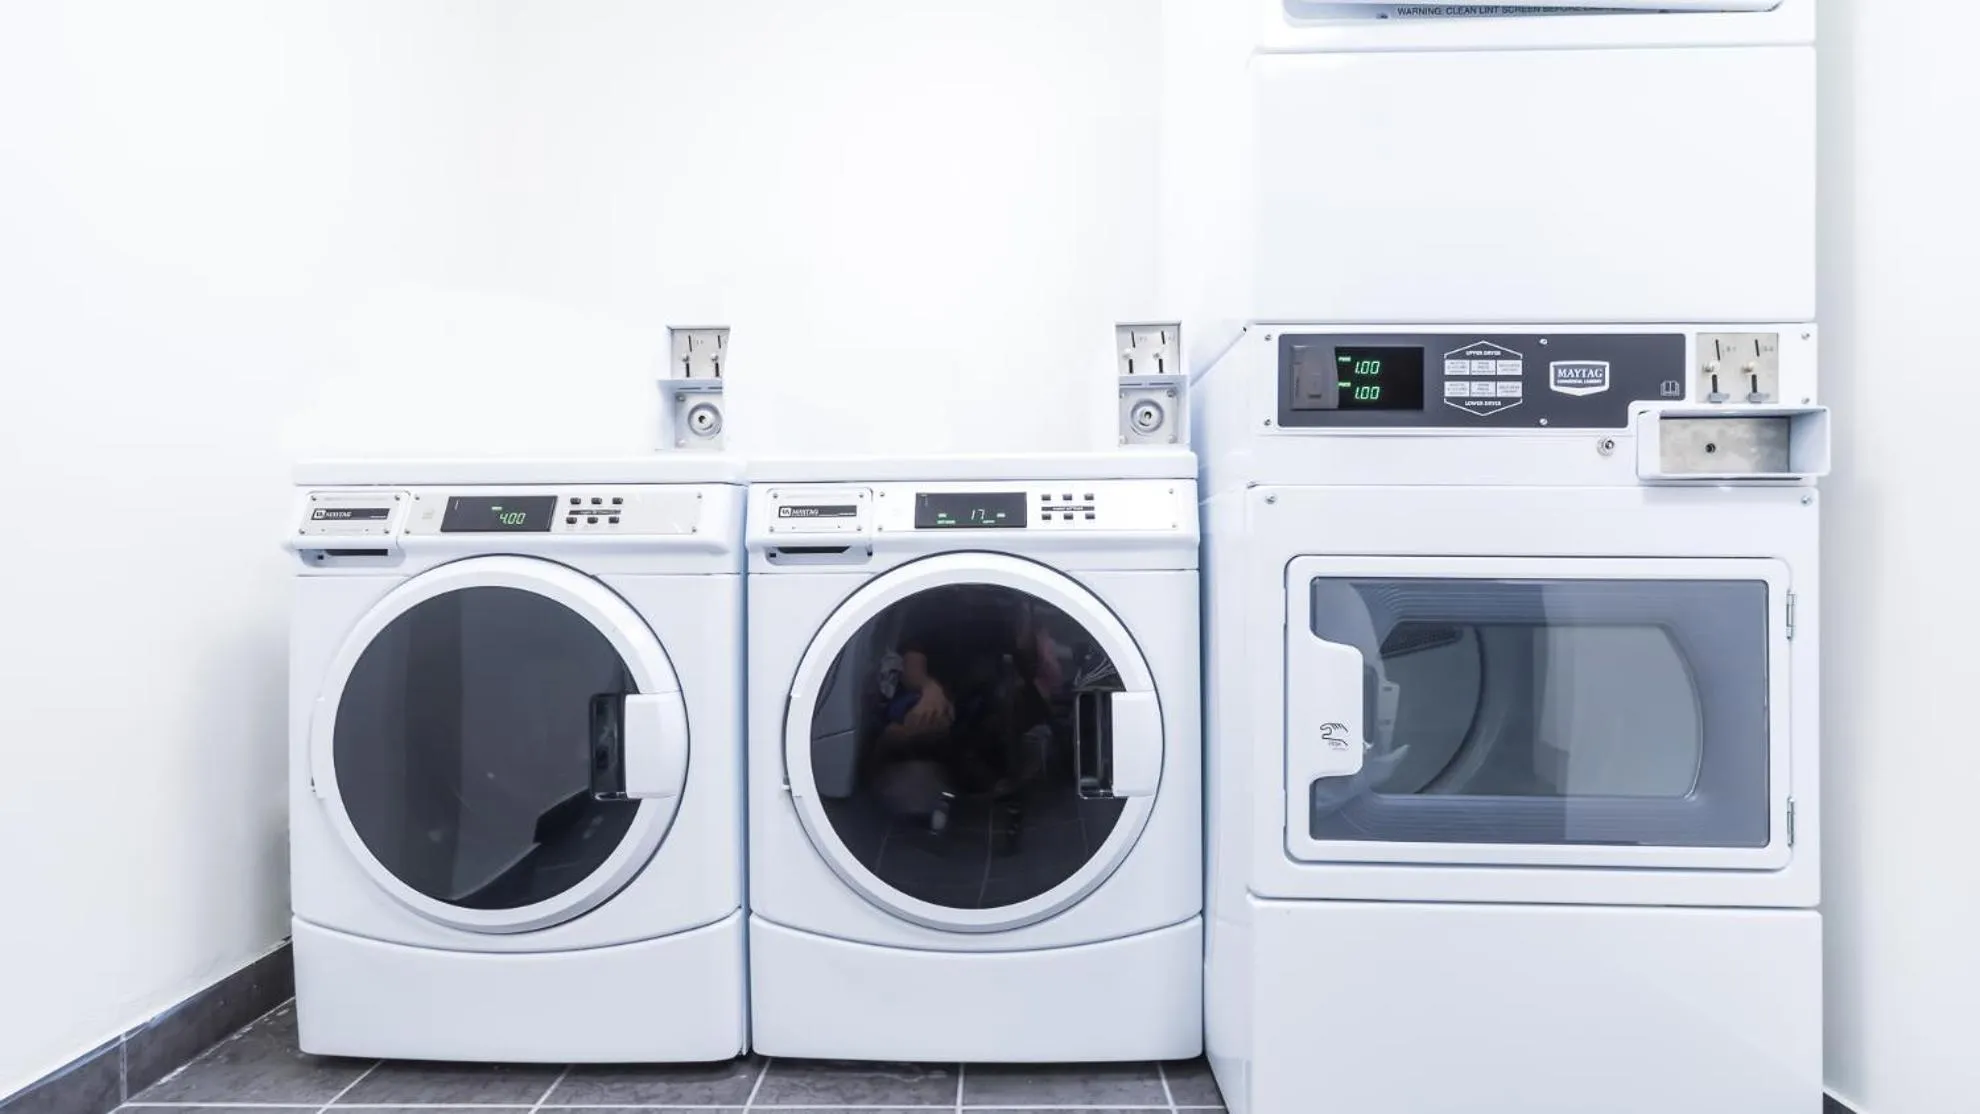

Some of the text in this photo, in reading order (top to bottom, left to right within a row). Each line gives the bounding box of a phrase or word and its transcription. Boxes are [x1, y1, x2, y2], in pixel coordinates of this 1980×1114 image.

[1446, 6, 1477, 15] CLEAN
[1479, 6, 1499, 14] LINT
[1355, 361, 1380, 374] 1.00
[1558, 368, 1603, 378] MAYTAG
[1355, 386, 1380, 400] 1.00
